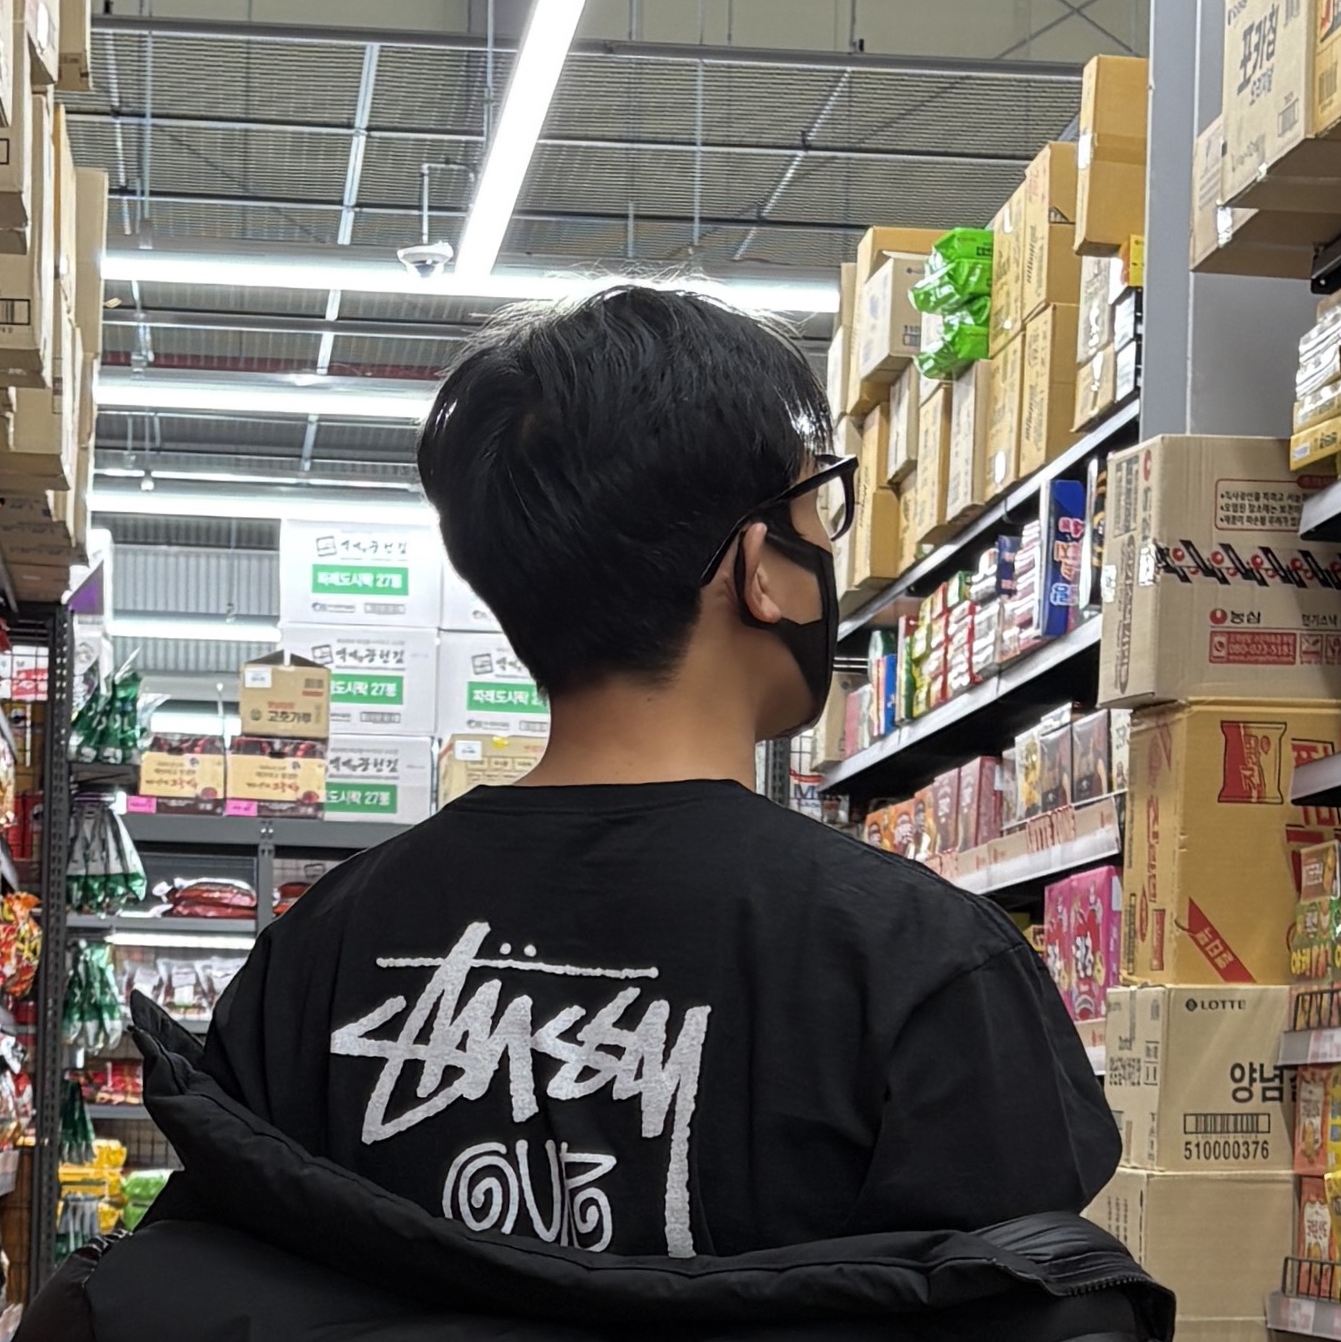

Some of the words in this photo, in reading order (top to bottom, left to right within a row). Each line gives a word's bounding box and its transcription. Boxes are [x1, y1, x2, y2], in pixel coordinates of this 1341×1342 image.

[1230, 611, 1261, 624] 농심
[1200, 1000, 1247, 1011] LOTTE
[1184, 1140, 1270, 1161] 510000376
